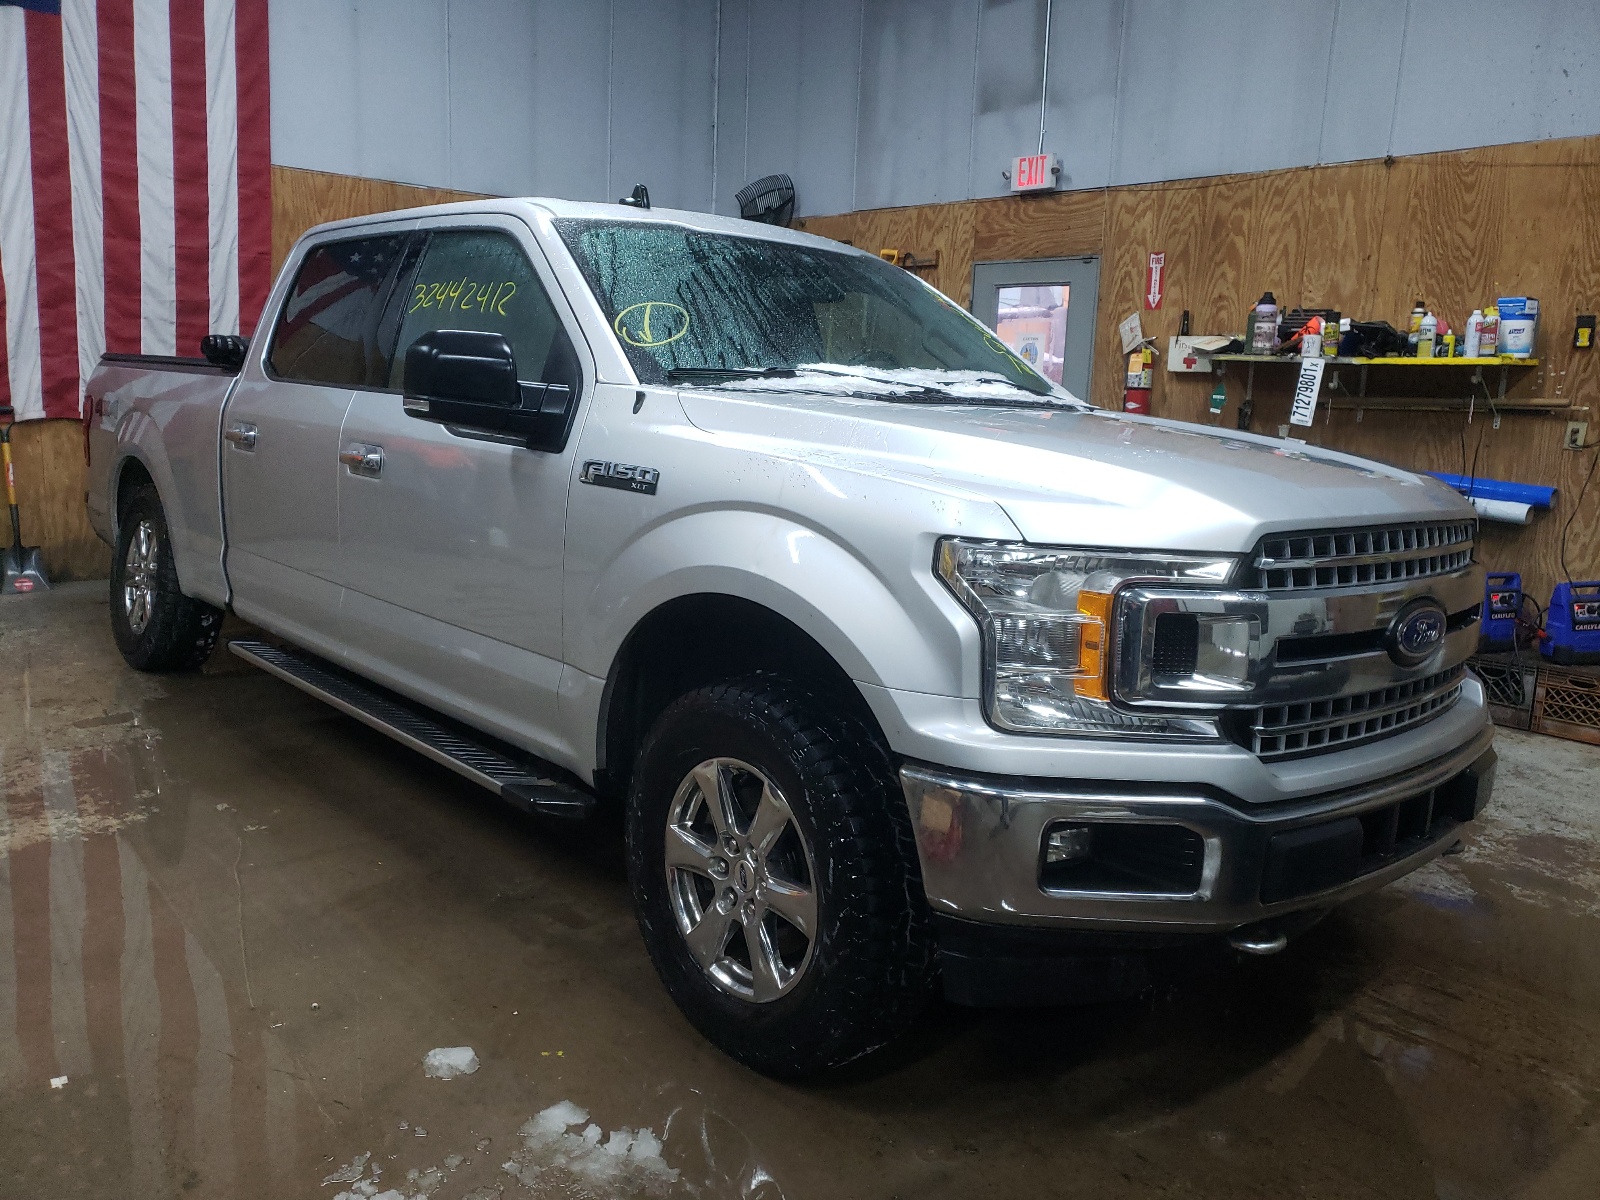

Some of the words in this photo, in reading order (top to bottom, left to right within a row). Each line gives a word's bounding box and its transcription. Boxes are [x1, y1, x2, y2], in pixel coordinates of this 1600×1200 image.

[1018, 155, 1047, 187] EXIT
[1152, 257, 1163, 265] FIRE
[409, 277, 516, 316] 32442412
